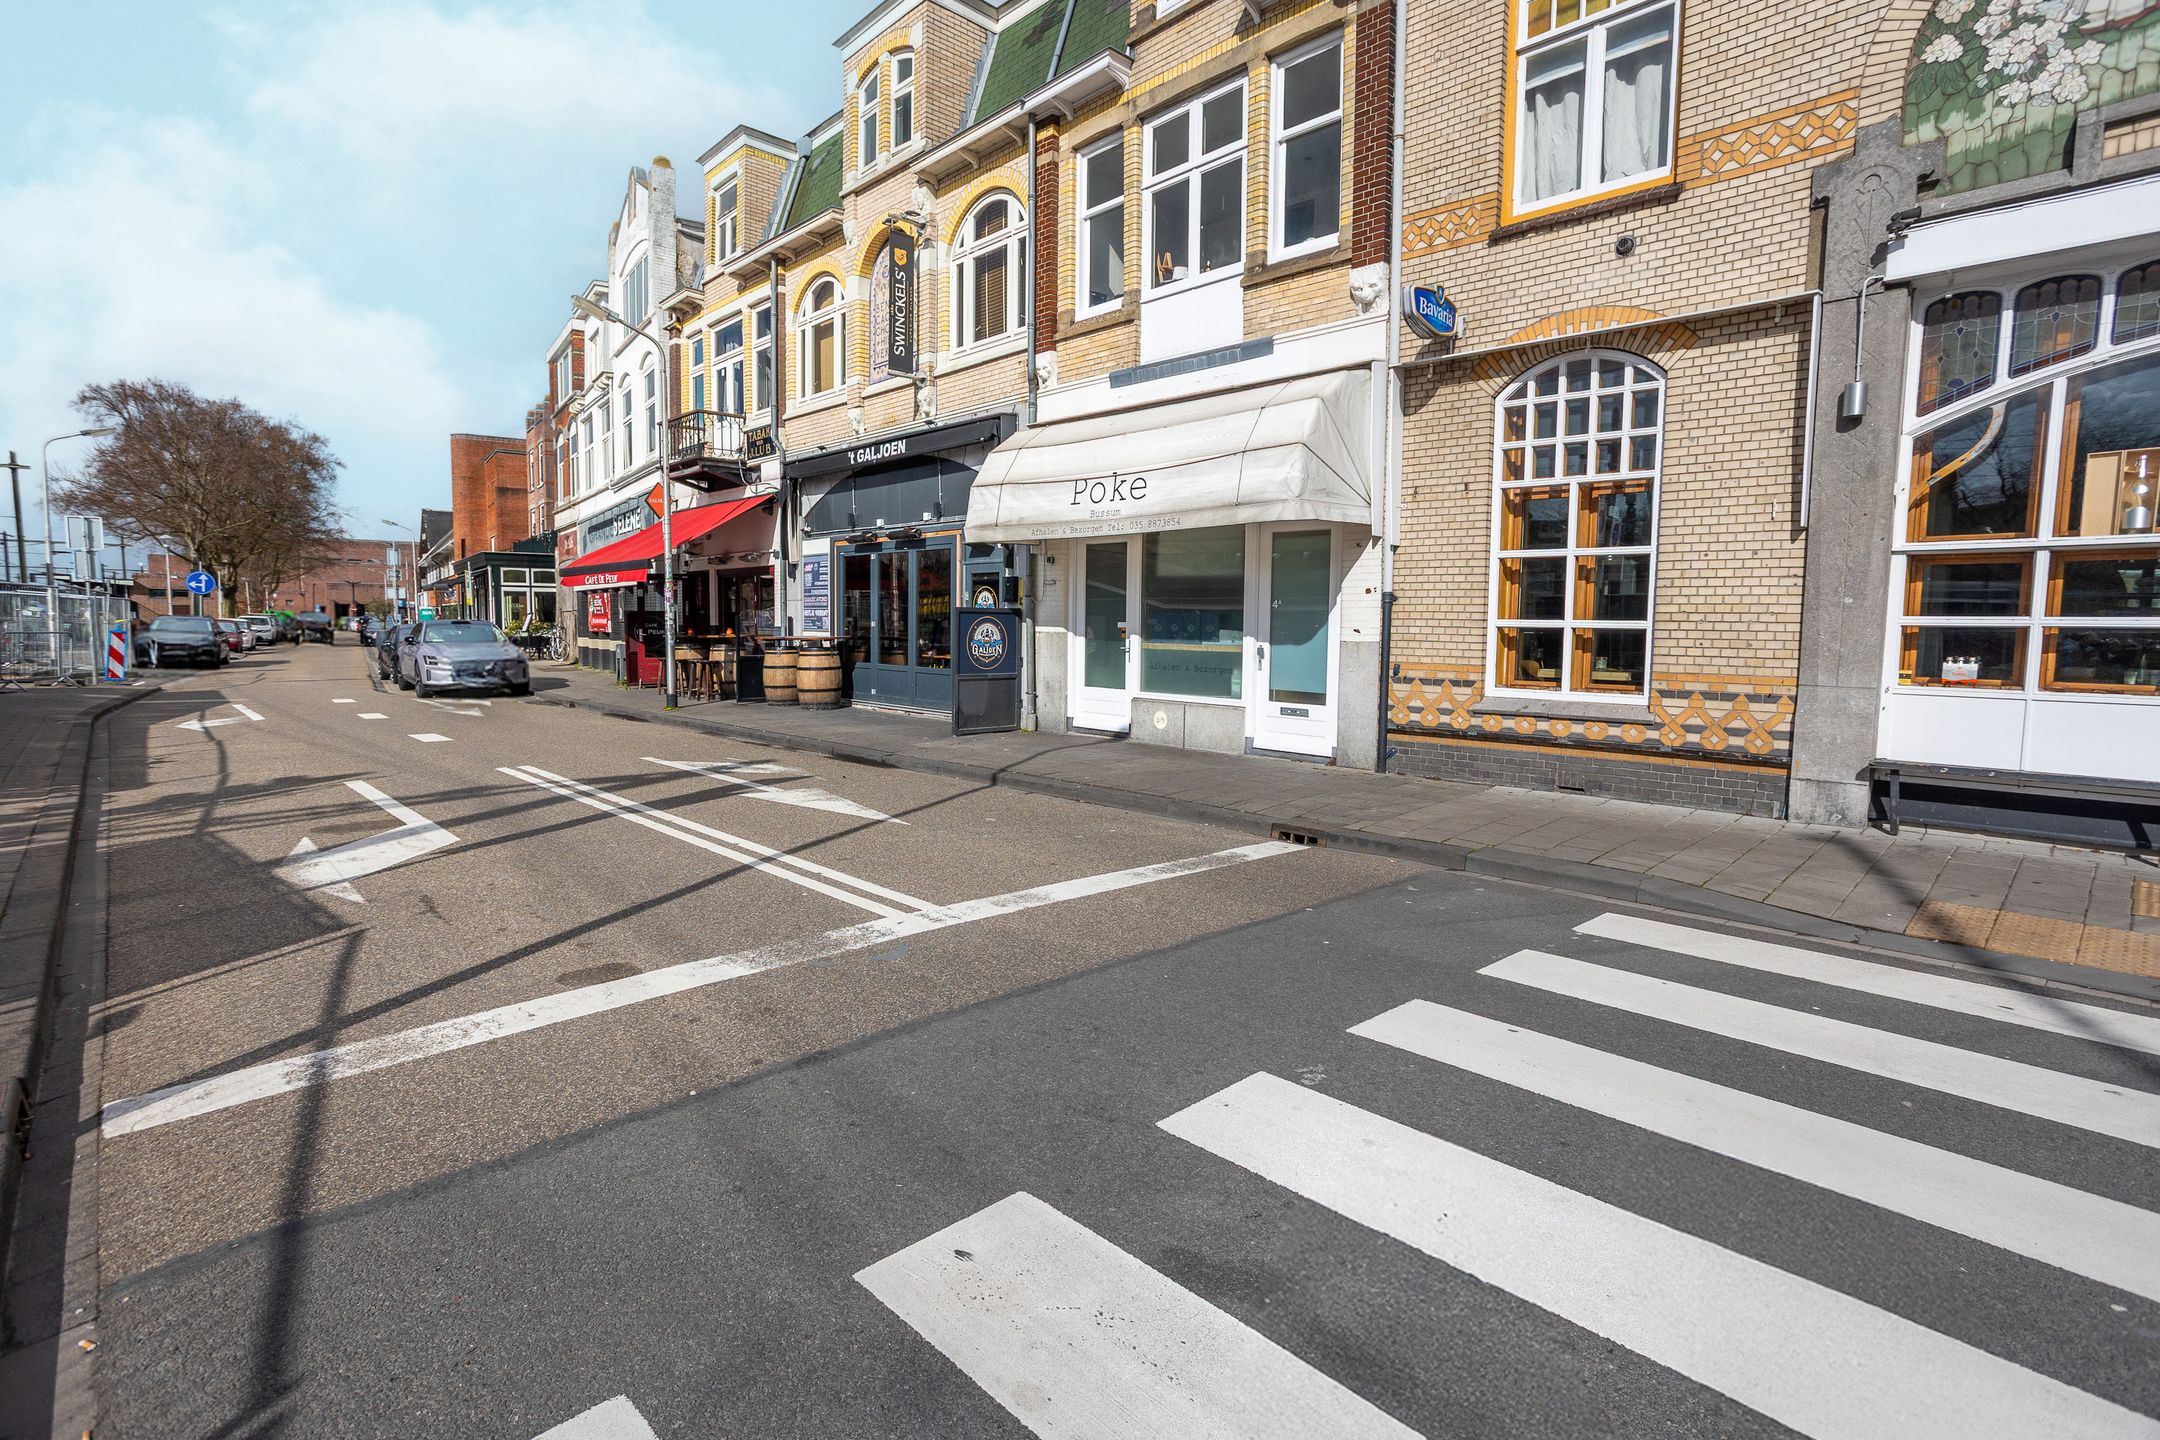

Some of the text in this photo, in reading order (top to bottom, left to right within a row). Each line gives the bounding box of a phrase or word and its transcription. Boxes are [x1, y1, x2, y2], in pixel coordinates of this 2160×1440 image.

[1419, 296, 1453, 328] Bavaria
[748, 427, 770, 442] TABAK
[847, 439, 906, 464] 't GALJOEN
[1071, 472, 1147, 505] Poke
[1090, 509, 1121, 519] Bussum
[1031, 528, 1058, 536] Afhalen
[1070, 525, 1103, 535] Bezorgen
[1107, 522, 1124, 531] Tel:
[1129, 521, 1144, 530] 035
[1148, 517, 1181, 528] 8873854
[598, 574, 604, 584] DE
